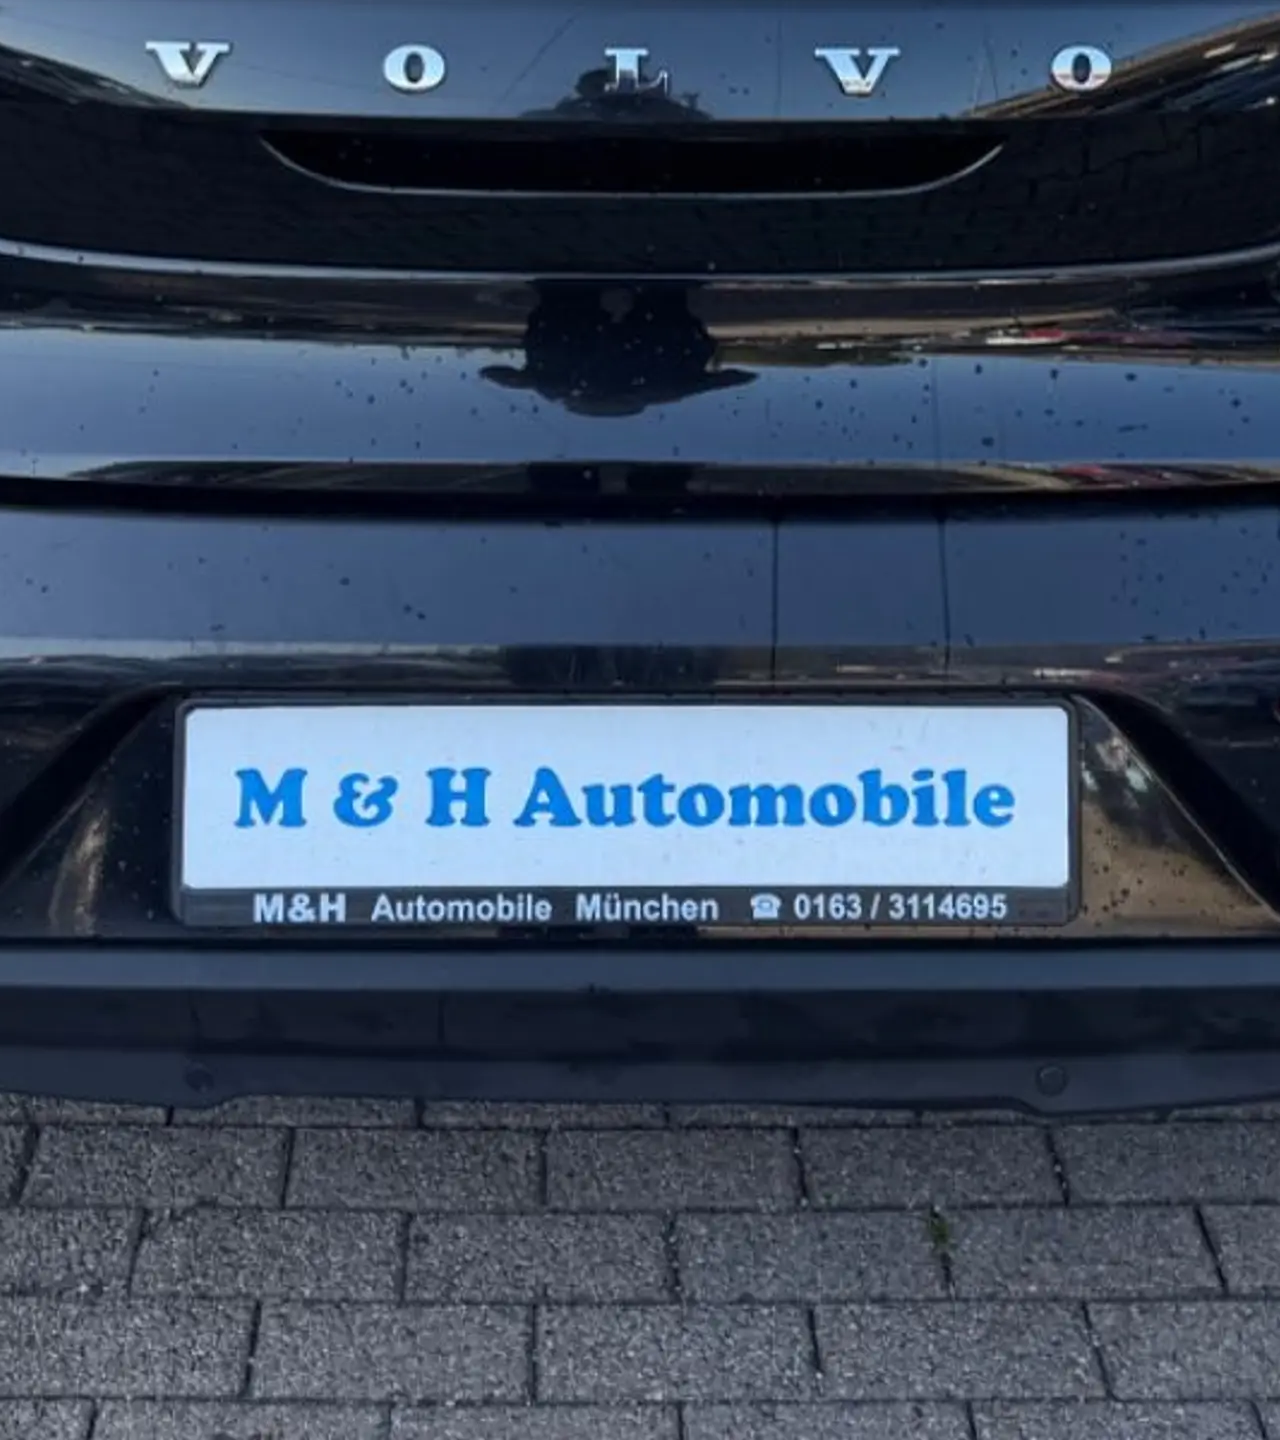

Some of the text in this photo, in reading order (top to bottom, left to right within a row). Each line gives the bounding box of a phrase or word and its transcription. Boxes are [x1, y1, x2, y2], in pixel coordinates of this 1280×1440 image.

[235, 766, 1015, 828] M & H Automobile
[253, 893, 346, 923] M&H
[371, 893, 552, 922] Automobile
[576, 892, 719, 922] München
[888, 893, 1008, 920] 3114695
